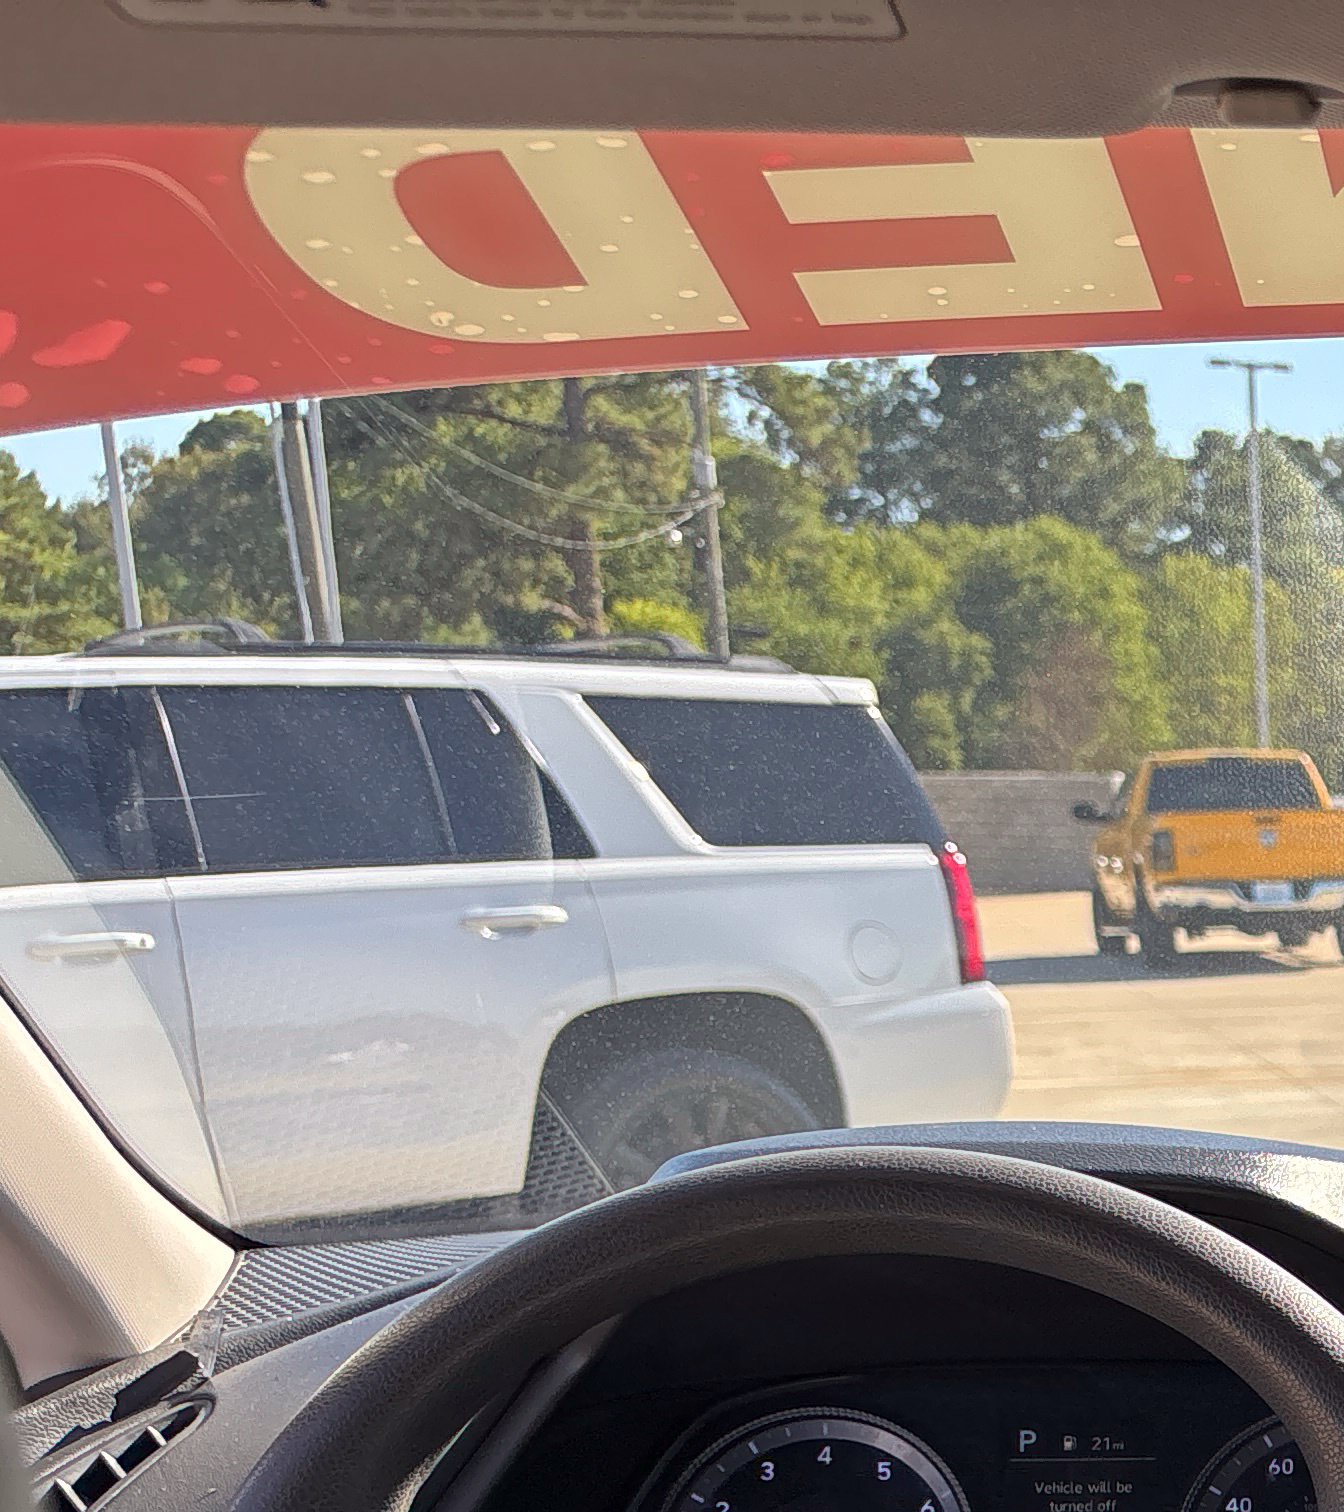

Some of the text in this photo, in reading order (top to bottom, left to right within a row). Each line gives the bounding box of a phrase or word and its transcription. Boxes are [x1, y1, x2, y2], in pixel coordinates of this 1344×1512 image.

[1019, 1429, 1037, 1453] P
[1091, 1437, 1111, 1451] 21
[817, 1445, 832, 1465] 4
[760, 1461, 775, 1481] 3
[877, 1461, 892, 1481] 5
[1268, 1458, 1295, 1476] 60
[1034, 1480, 1133, 1495] Vehicle will be
[1049, 1499, 1118, 1512] turned off
